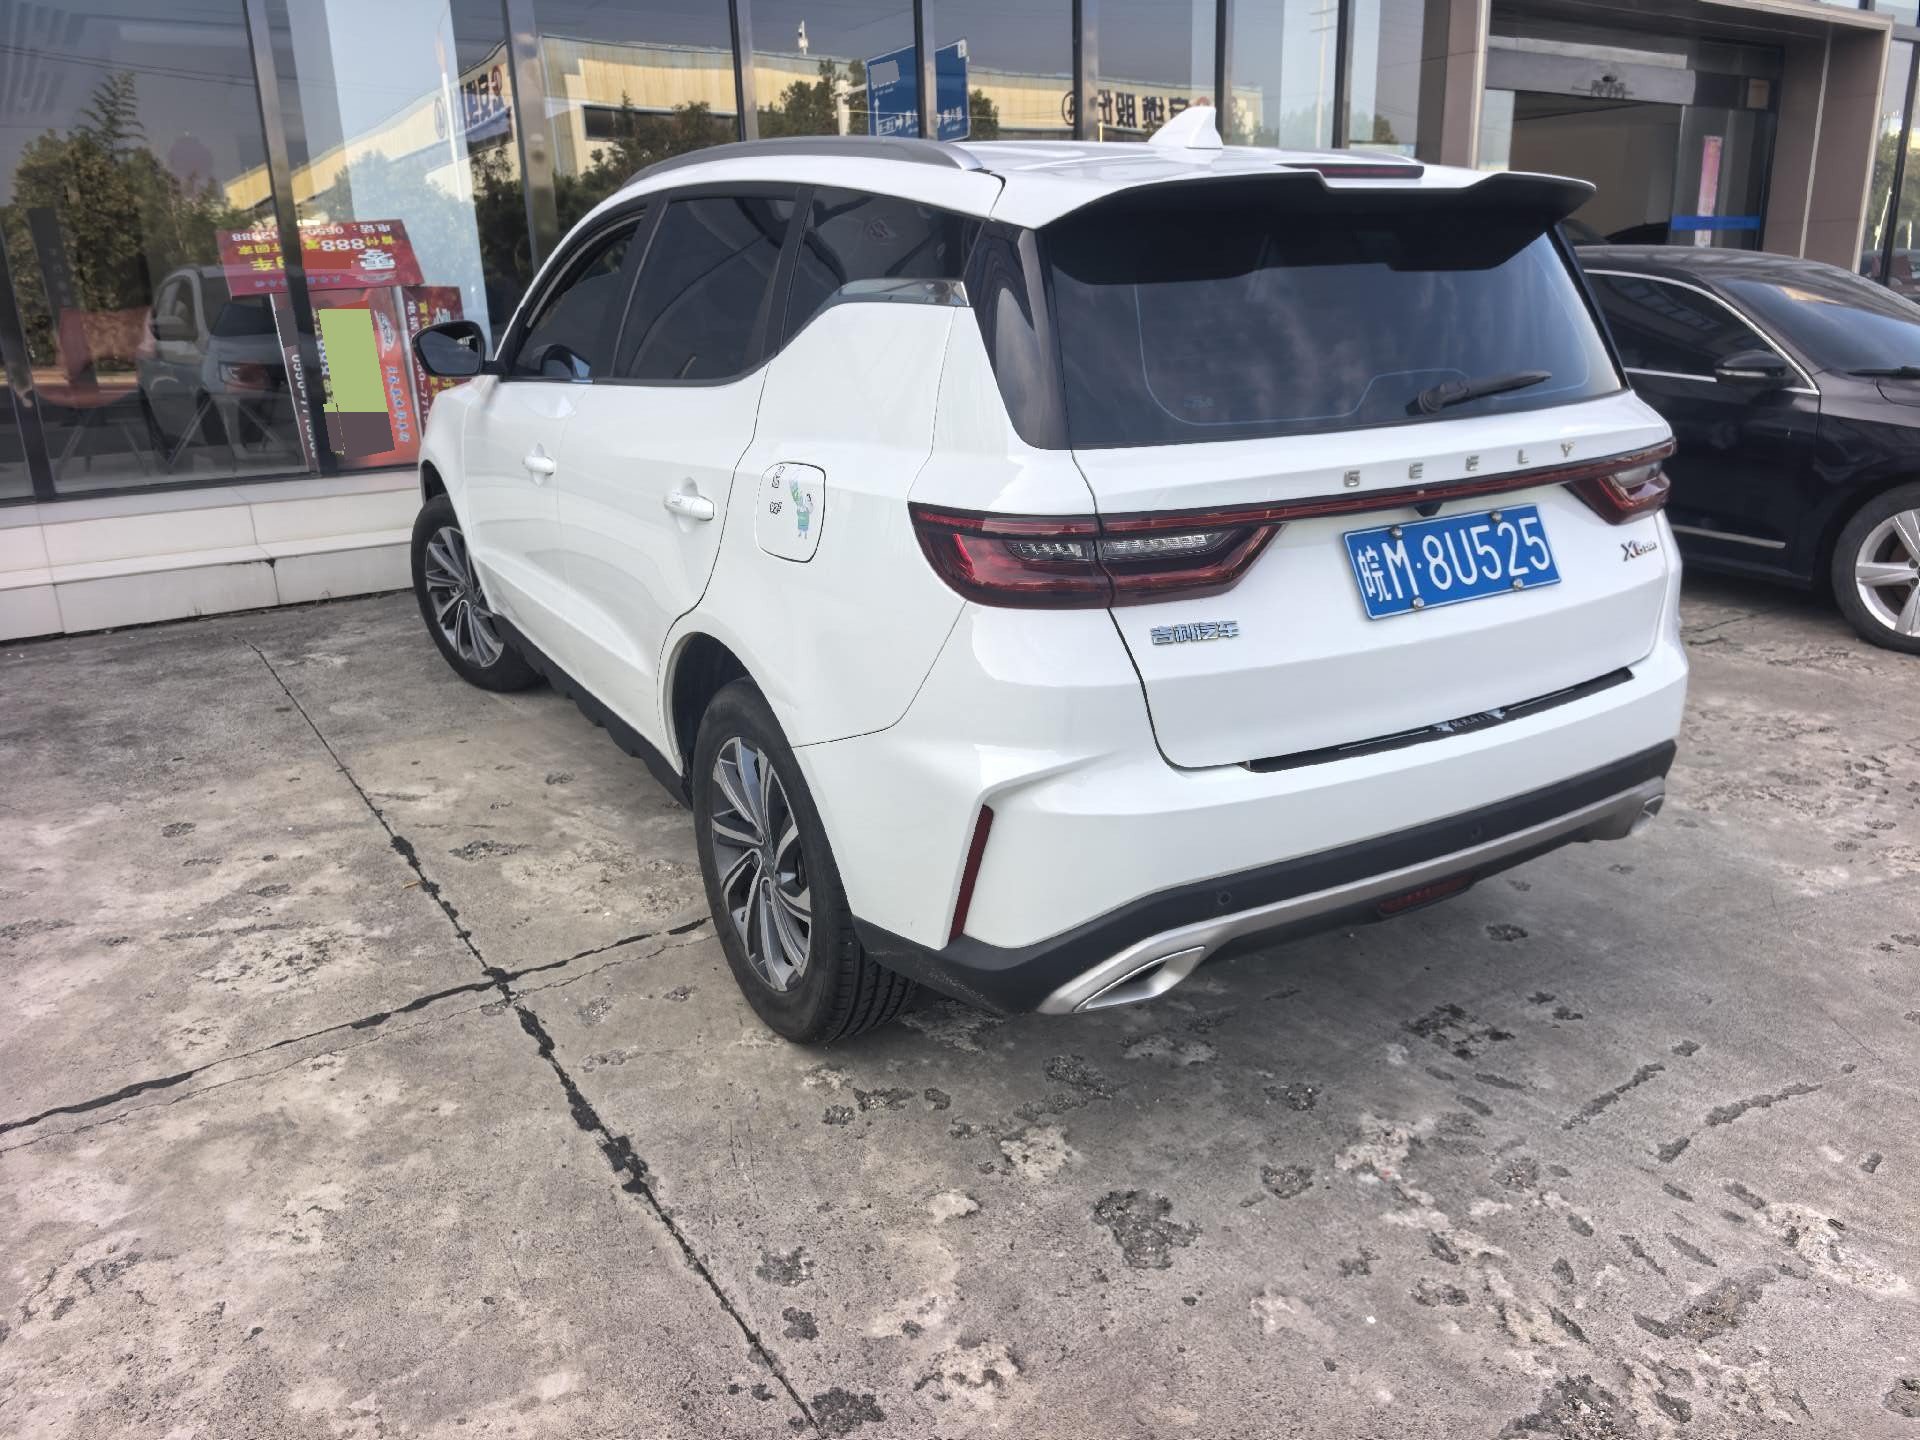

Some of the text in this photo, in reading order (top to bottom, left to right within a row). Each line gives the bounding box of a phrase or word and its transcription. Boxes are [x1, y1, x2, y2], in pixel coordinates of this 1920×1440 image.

[1343, 441, 1574, 488] GEELY
[1150, 620, 1240, 646] 吉利汽车
